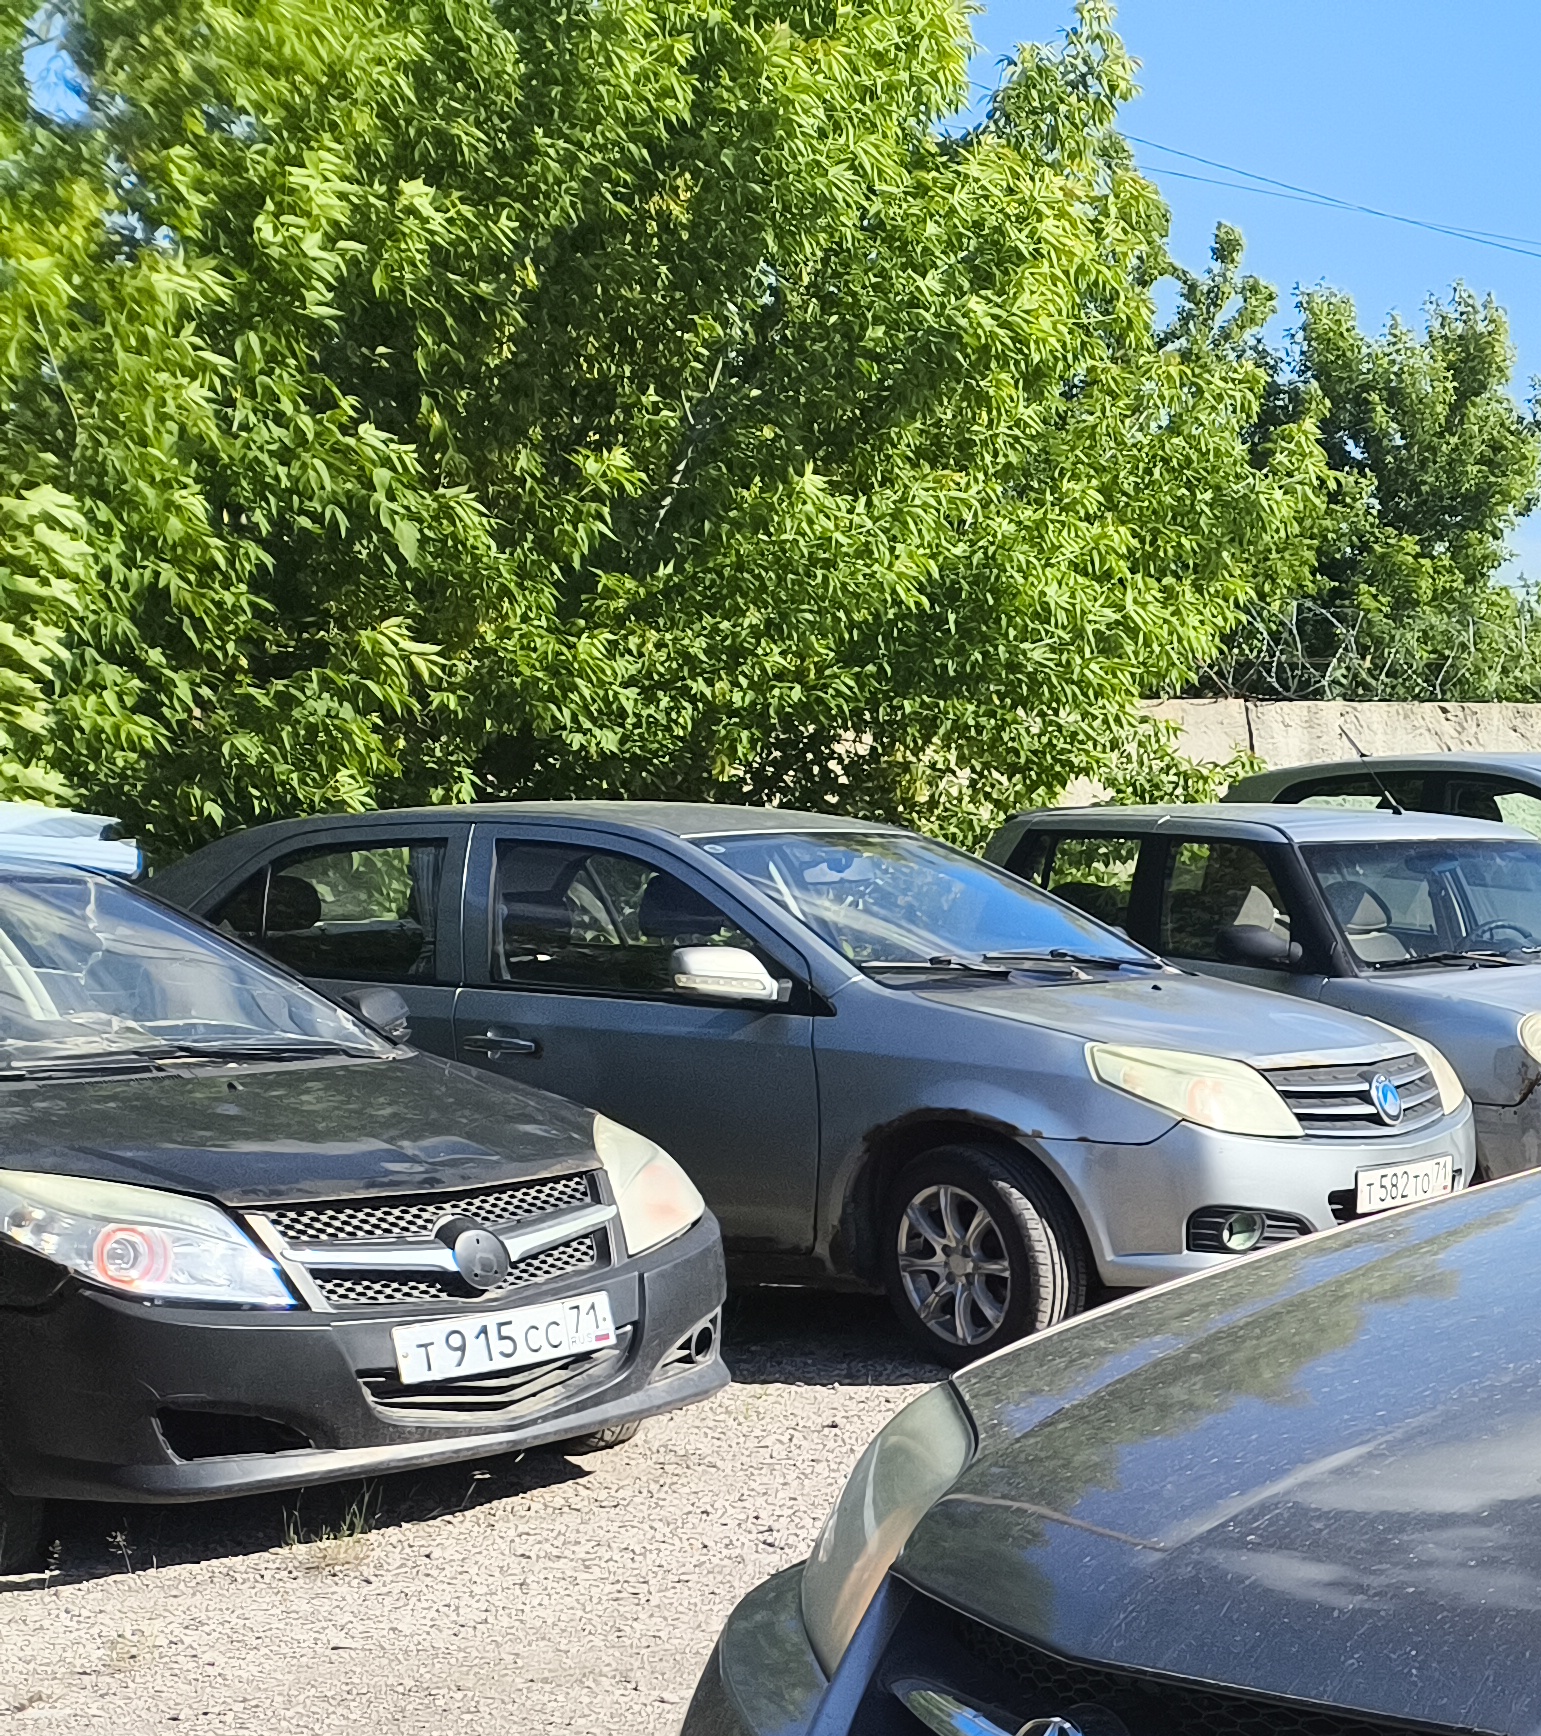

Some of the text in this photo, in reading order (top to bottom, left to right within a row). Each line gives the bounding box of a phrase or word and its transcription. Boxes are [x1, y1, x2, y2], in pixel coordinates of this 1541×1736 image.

[1366, 1159, 1448, 1205] Т582ТО 71
[415, 1301, 600, 1373] Т915СС 71
[571, 1333, 594, 1346] RUS
